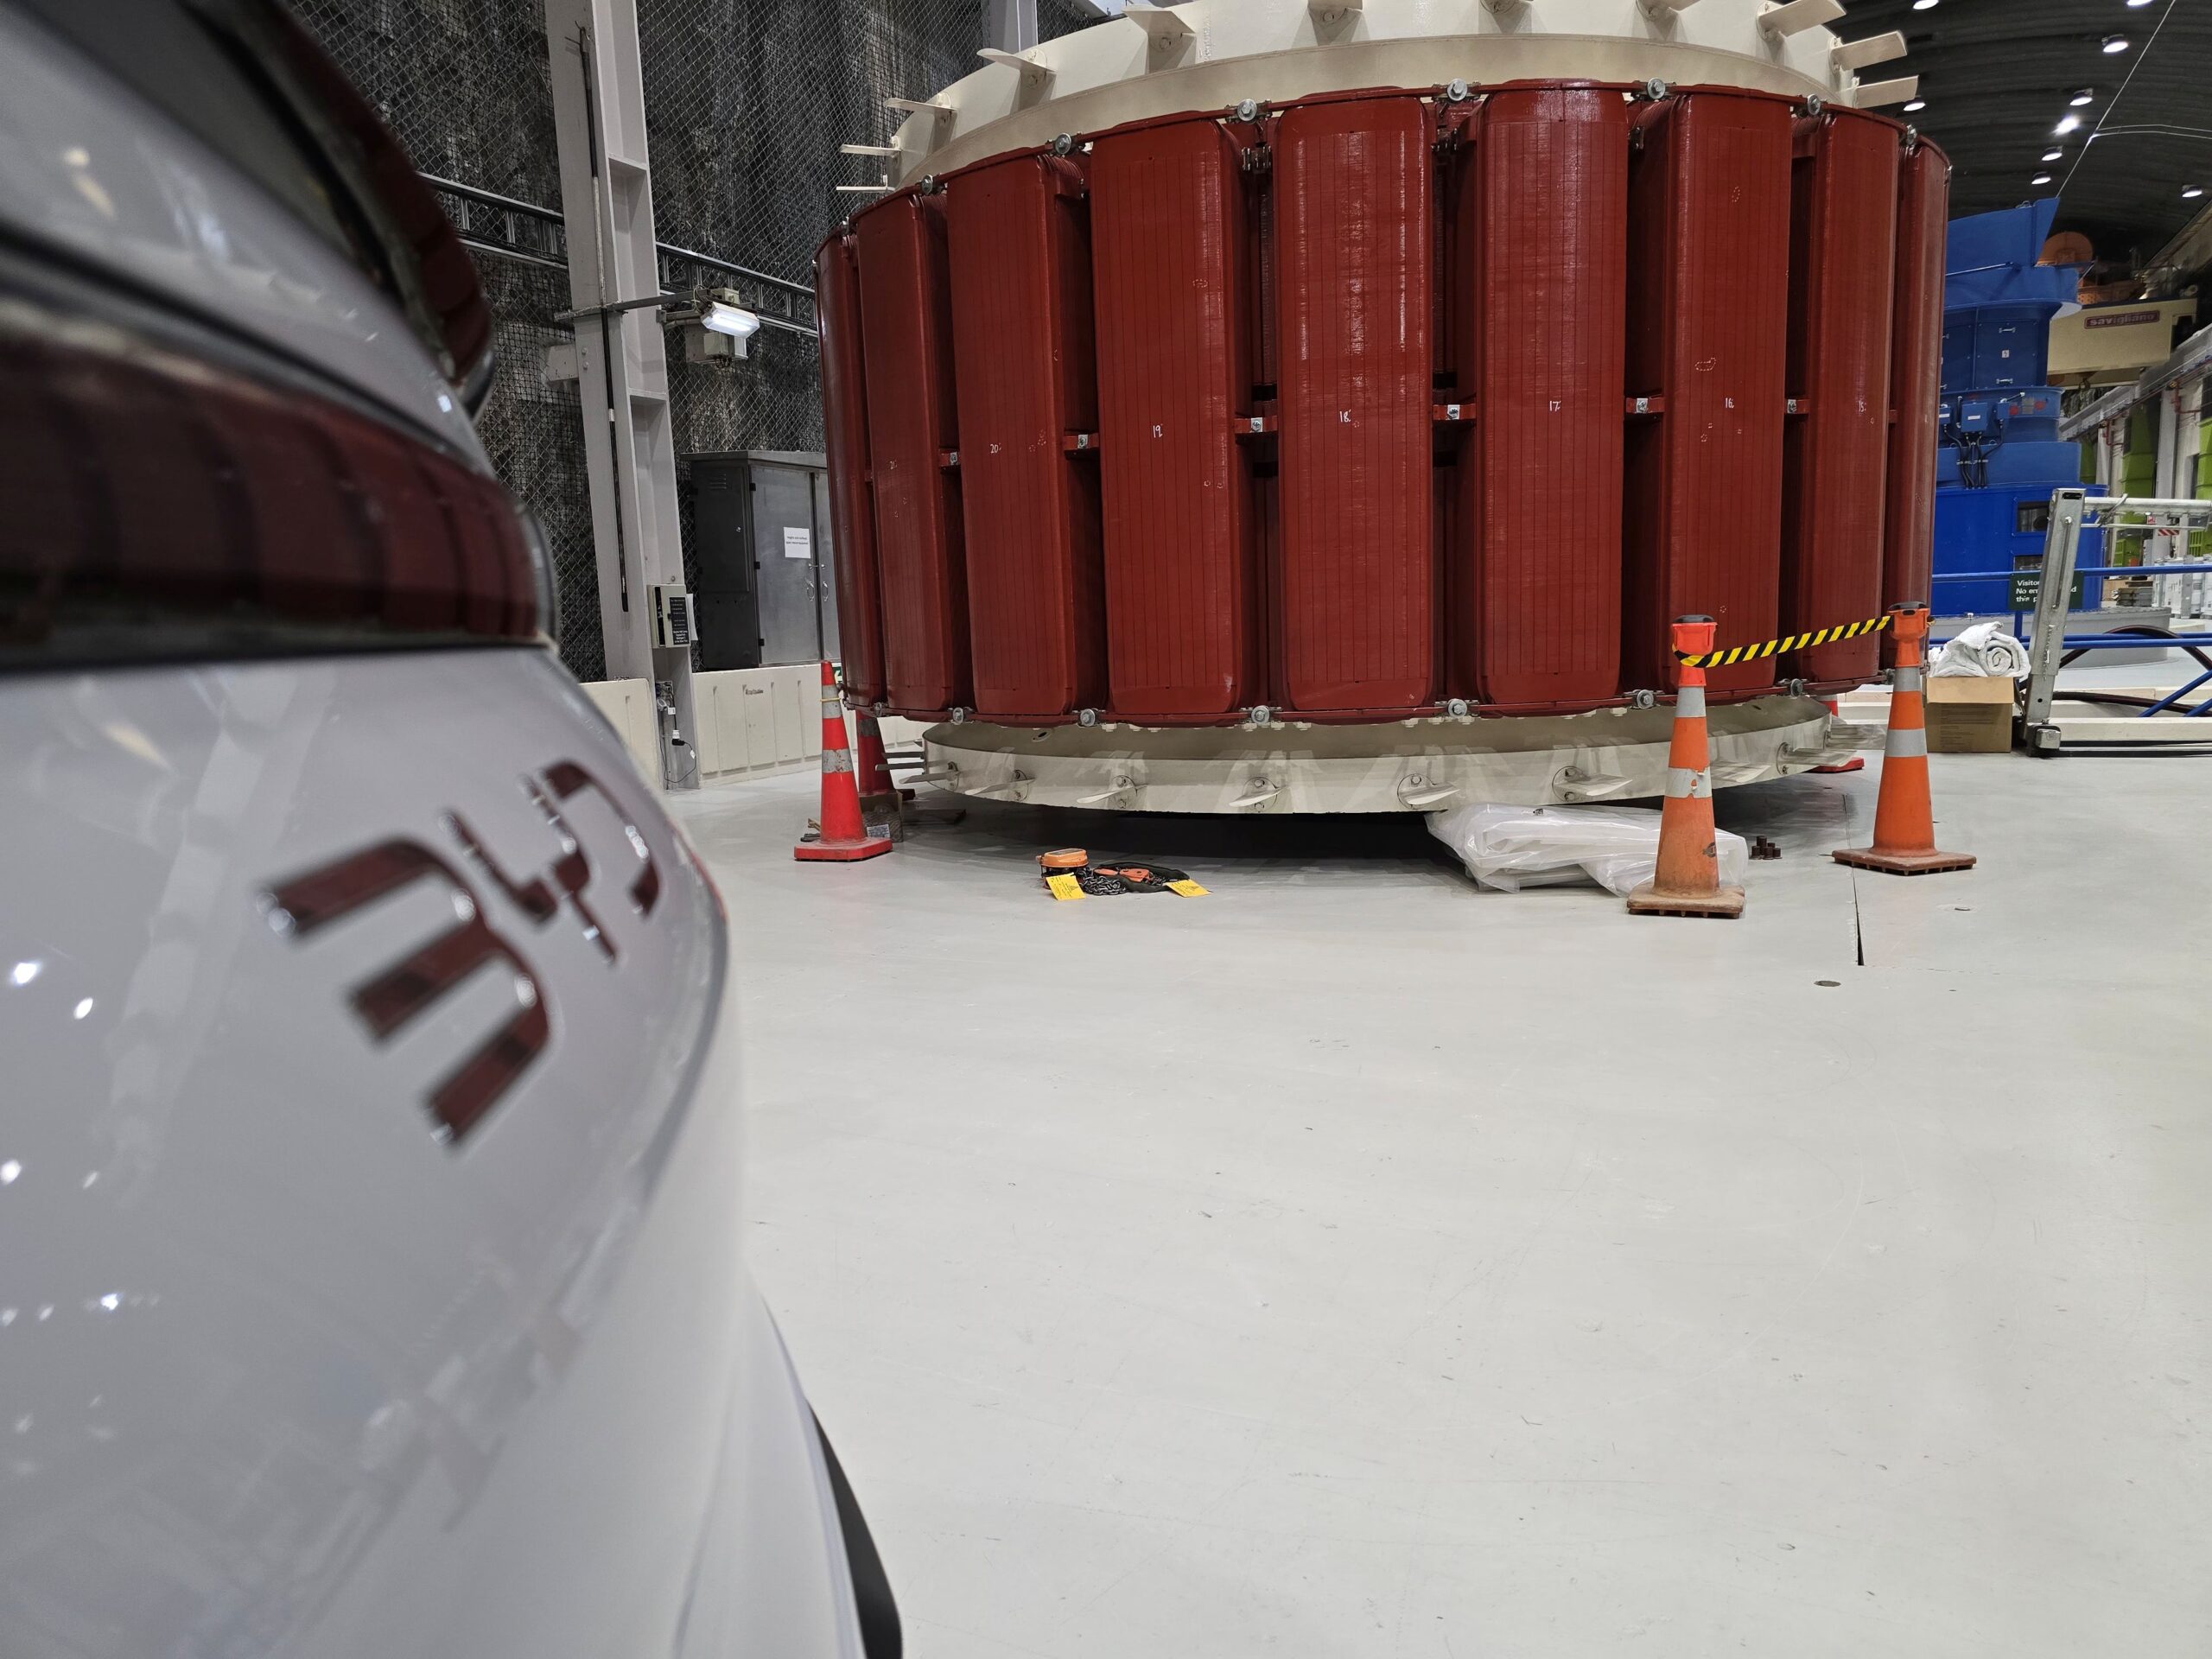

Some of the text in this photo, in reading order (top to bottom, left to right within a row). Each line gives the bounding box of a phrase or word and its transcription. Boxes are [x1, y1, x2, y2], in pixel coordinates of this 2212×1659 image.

[2089, 313, 2156, 326] savigliano
[1549, 400, 1560, 411] 17
[1725, 397, 1734, 408] 16
[1339, 410, 1350, 423] 18
[1153, 424, 1162, 438] 19
